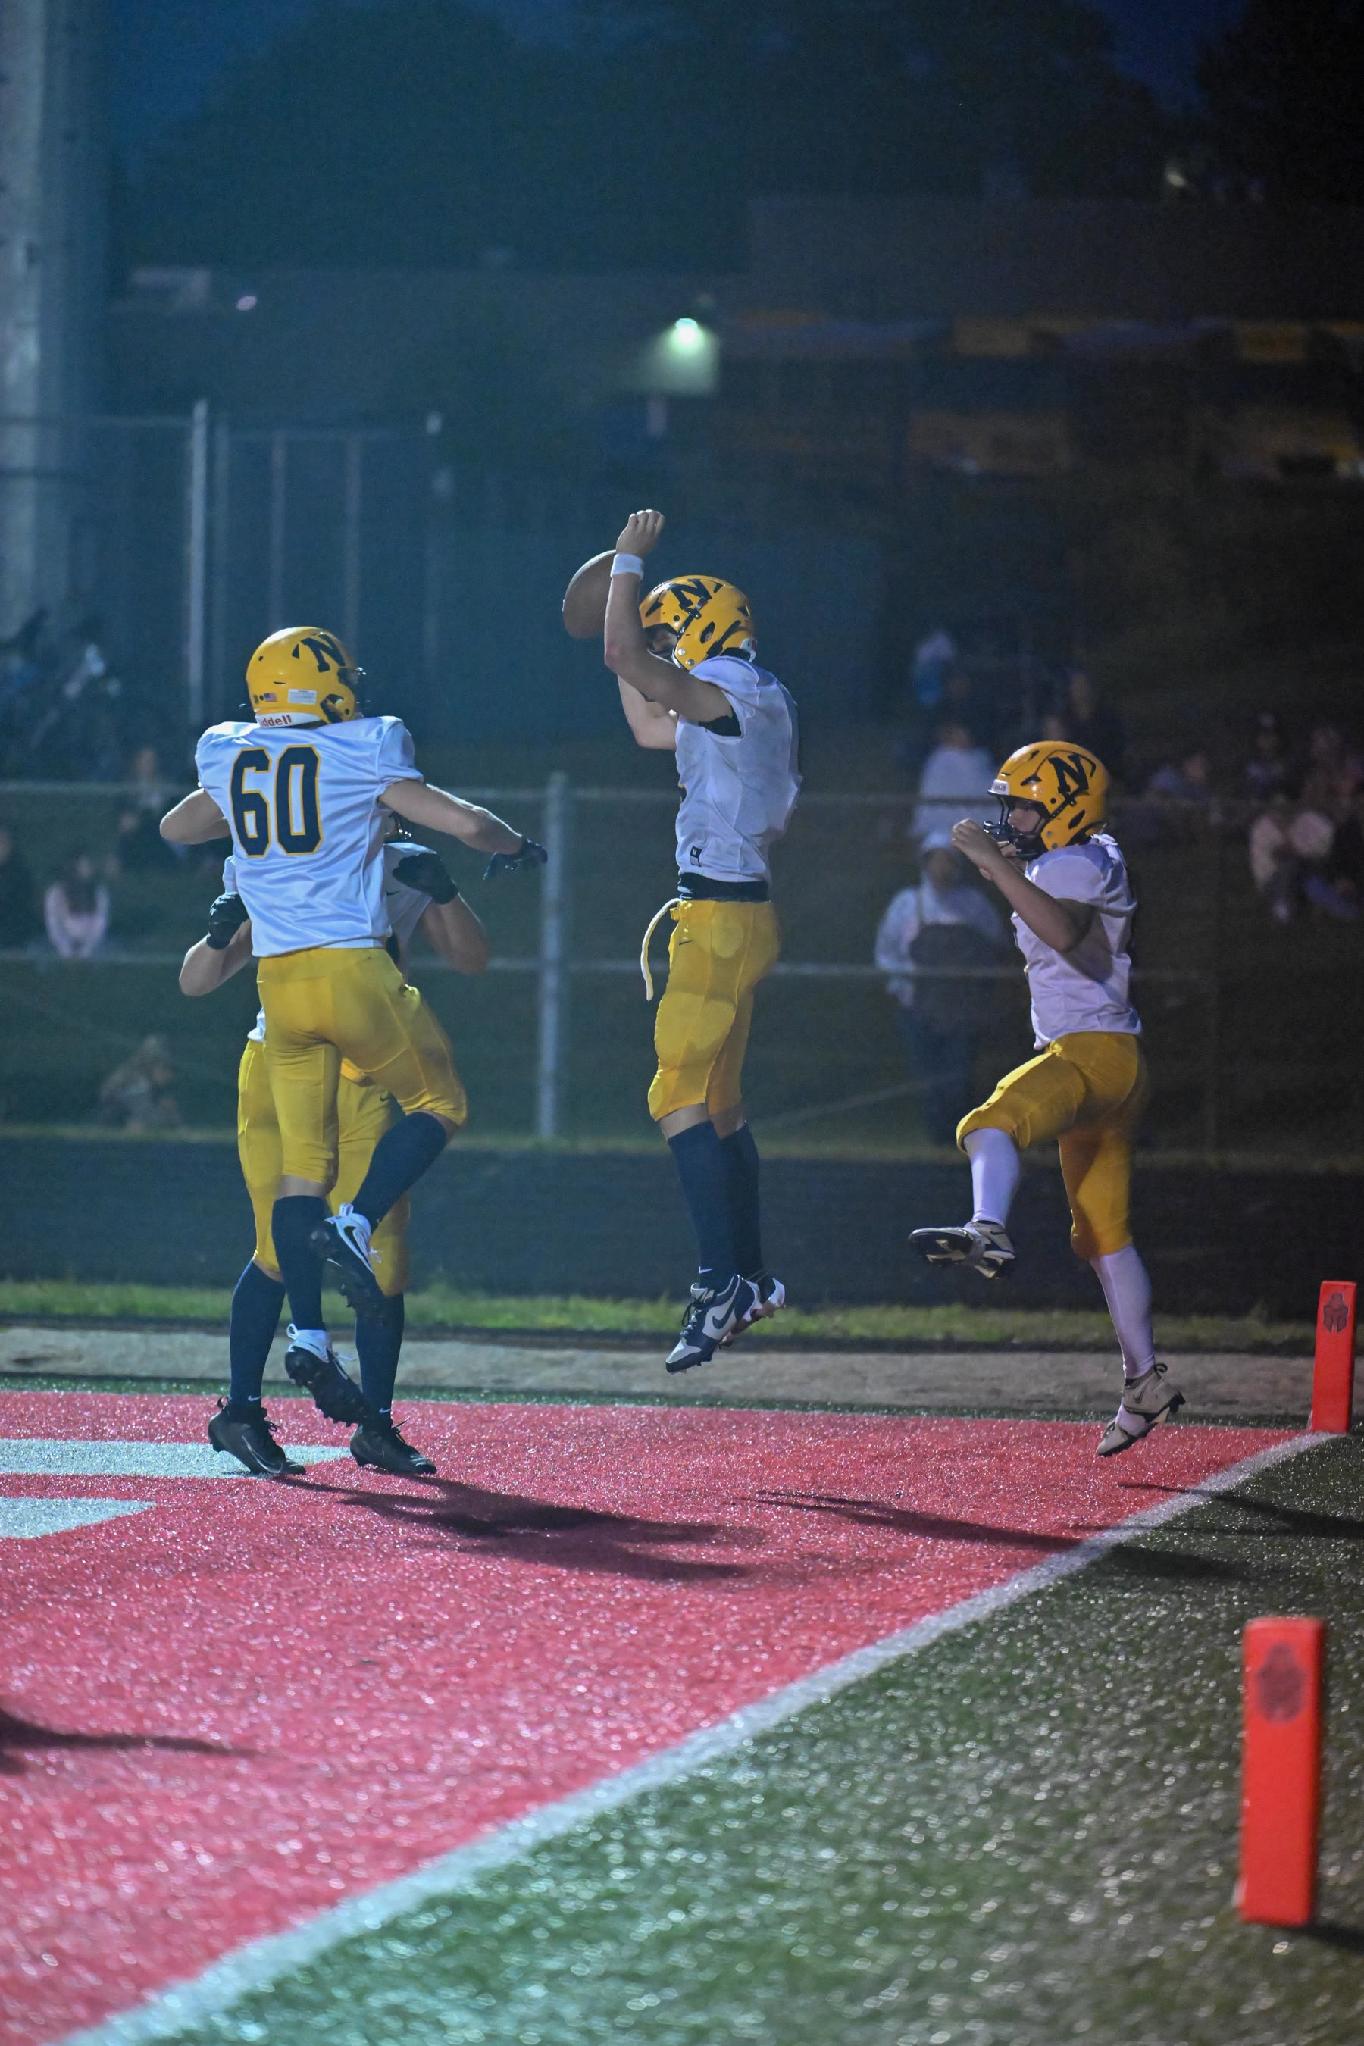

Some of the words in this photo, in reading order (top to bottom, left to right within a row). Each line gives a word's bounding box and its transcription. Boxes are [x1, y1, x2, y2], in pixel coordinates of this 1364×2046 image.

[669, 579, 712, 612] N
[300, 632, 346, 673] N
[1047, 752, 1090, 794] N
[229, 744, 323, 858] 60
